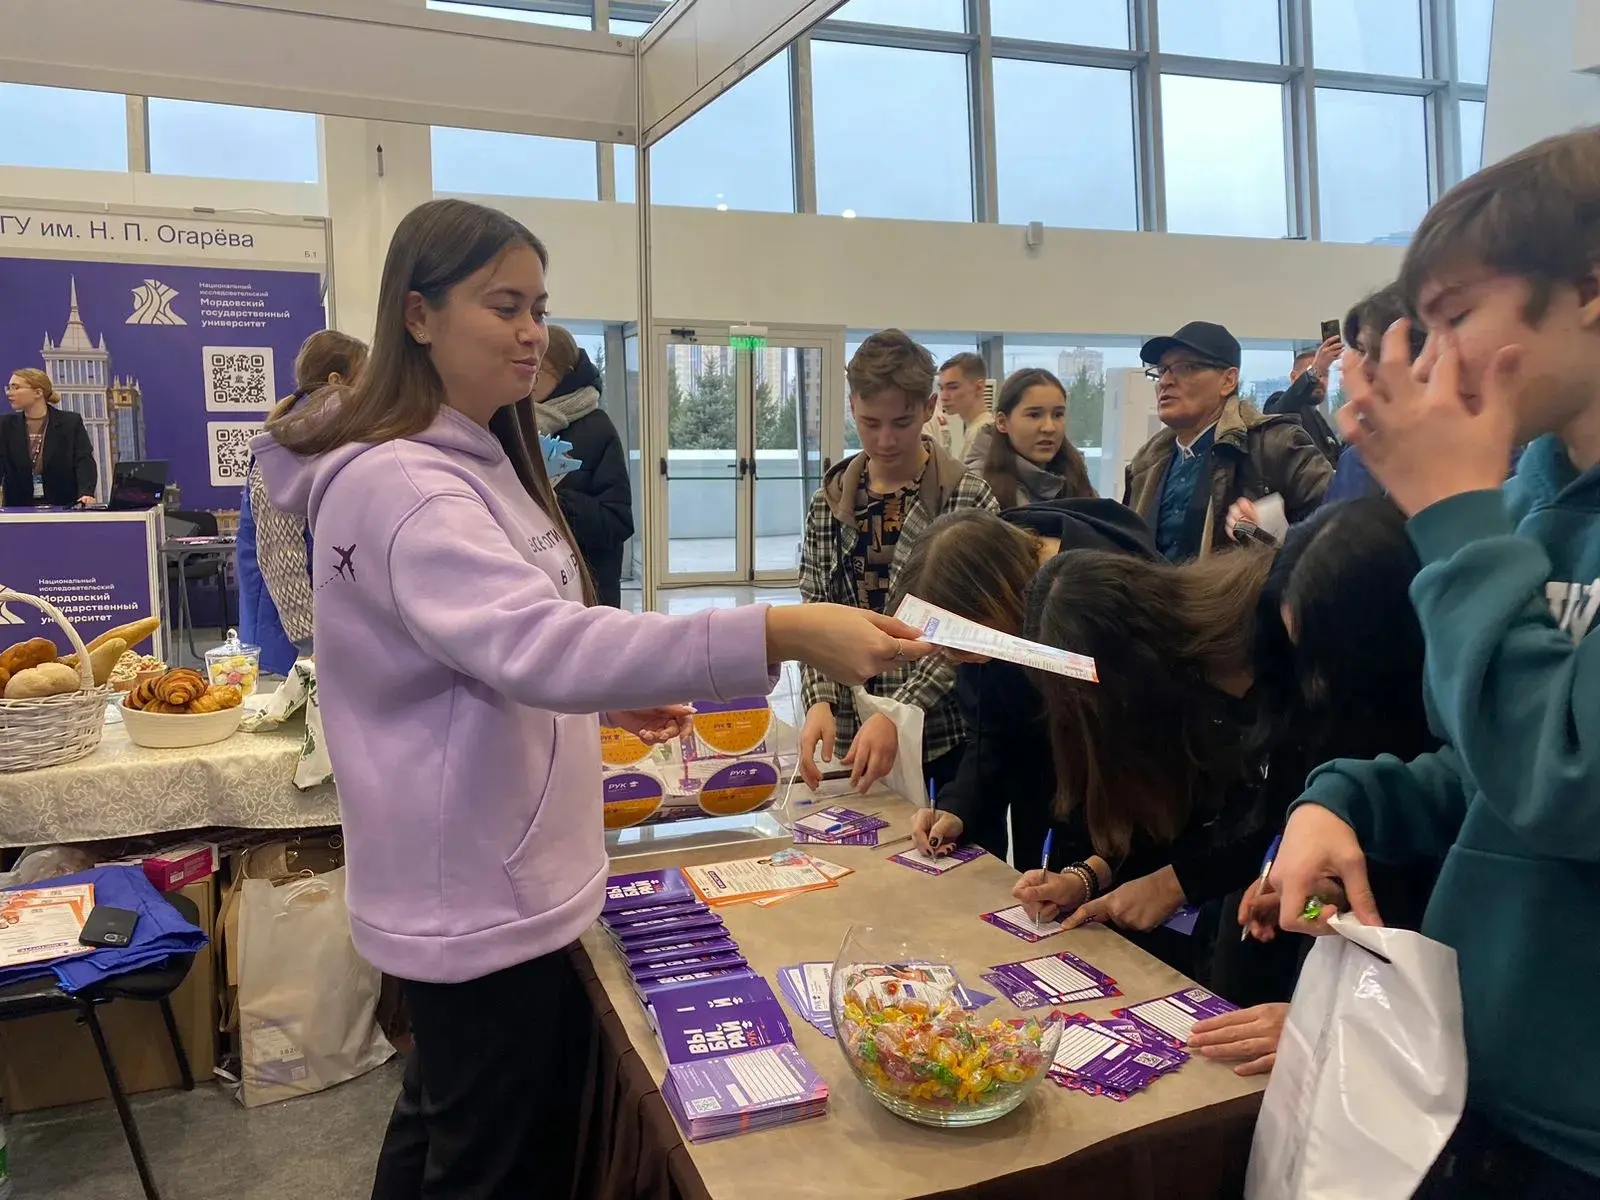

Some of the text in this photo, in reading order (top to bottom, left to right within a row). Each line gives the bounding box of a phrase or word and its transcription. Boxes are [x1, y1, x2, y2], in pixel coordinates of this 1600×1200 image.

[40, 221, 80, 239] им.
[90, 221, 114, 241] Н.
[124, 222, 149, 243] П.
[157, 224, 254, 250] Огарёва
[199, 282, 252, 290] Национальный
[200, 298, 265, 307] Мордовский
[201, 308, 290, 318] государственный
[201, 319, 266, 328] университет
[38, 577, 97, 585] Национальный
[39, 584, 115, 592] исследовательский
[40, 593, 111, 603] Мордовский
[608, 781, 627, 790] РУК
[716, 1020, 749, 1049] РАЙ
[746, 1030, 760, 1047] РУК
[683, 1028, 709, 1054] ВЫ
[704, 1030, 729, 1052] БИ
